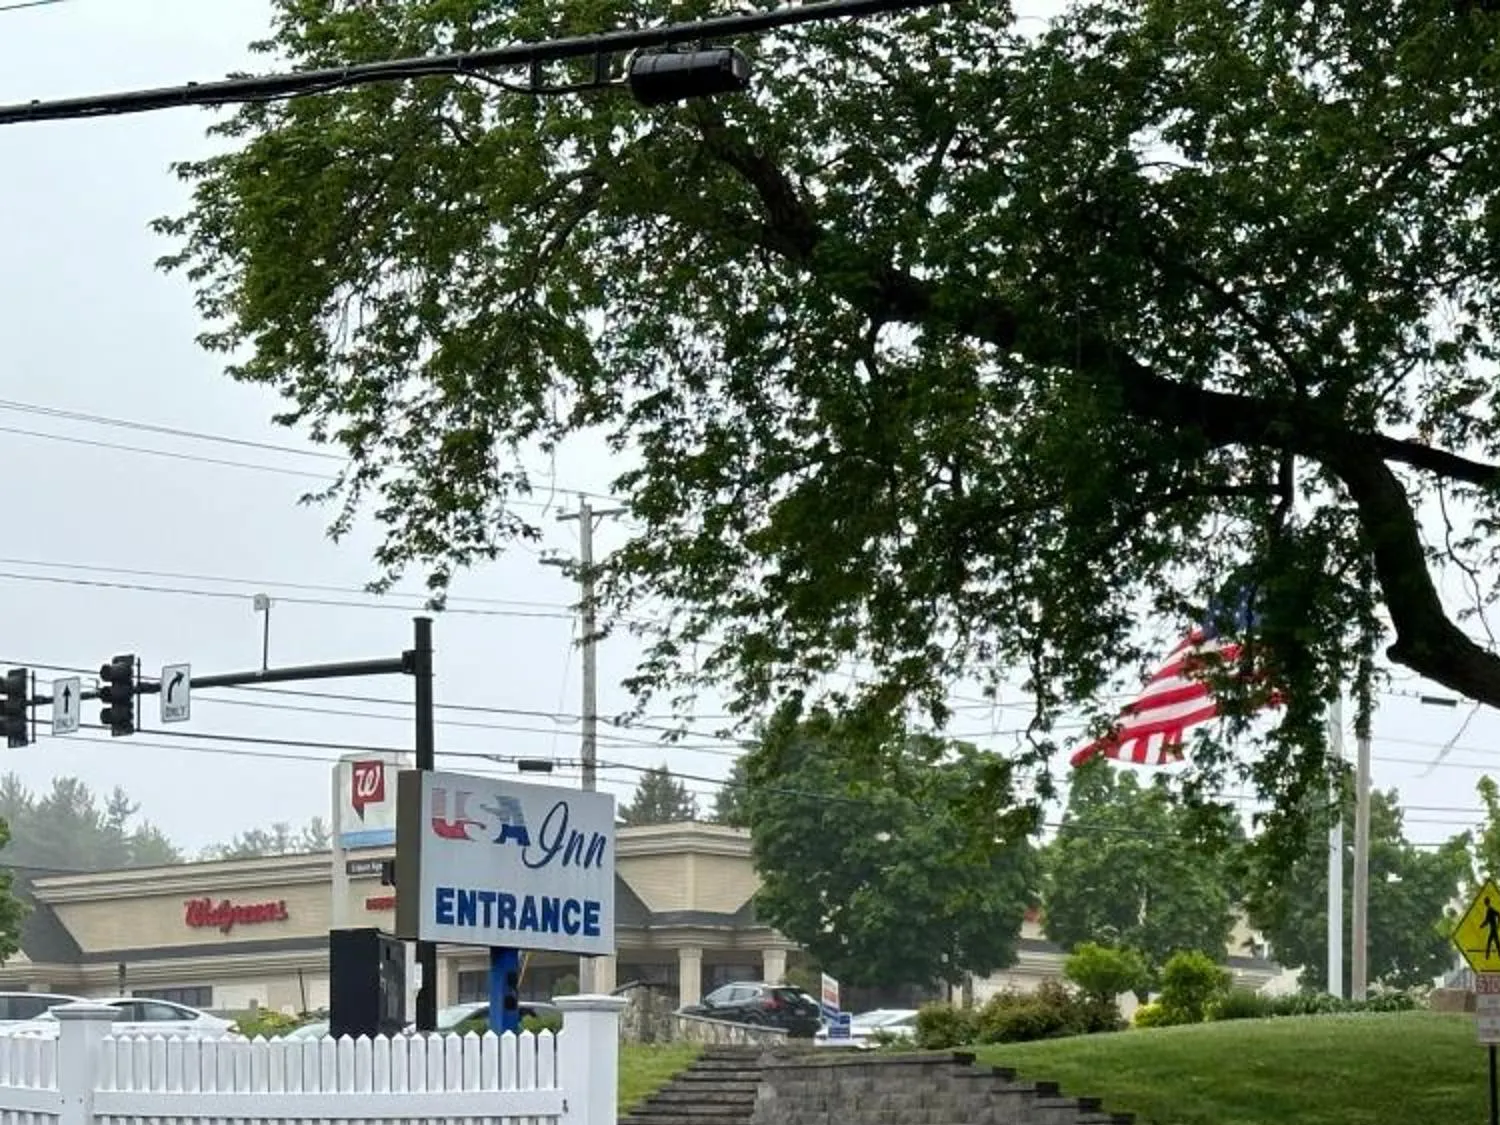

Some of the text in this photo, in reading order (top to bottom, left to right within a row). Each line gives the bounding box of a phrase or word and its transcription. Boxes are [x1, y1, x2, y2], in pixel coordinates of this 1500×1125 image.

[431, 787, 607, 870] USA Inn
[435, 887, 601, 937] ENTRANCE
